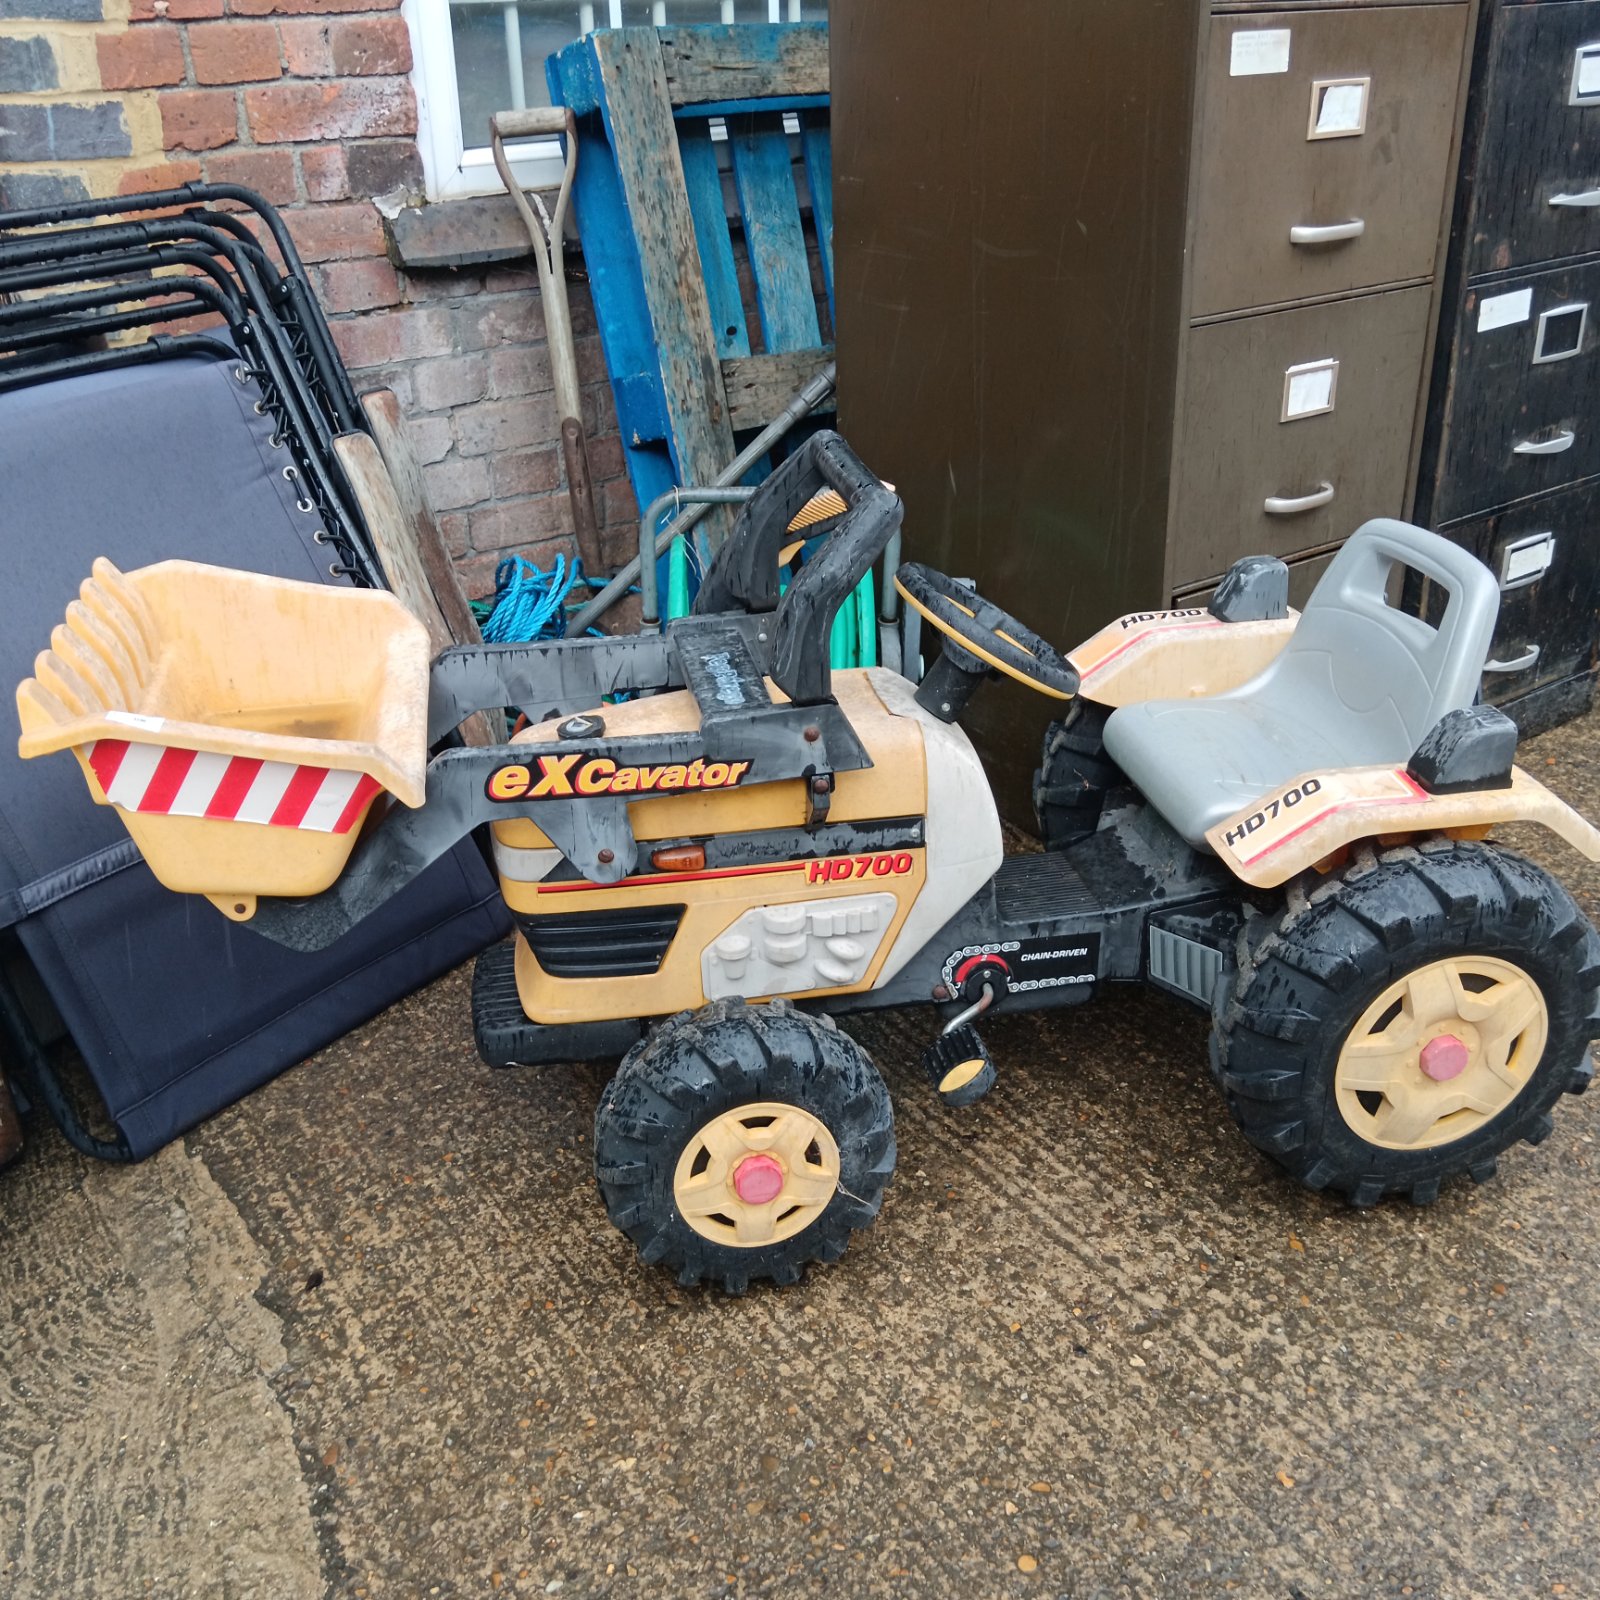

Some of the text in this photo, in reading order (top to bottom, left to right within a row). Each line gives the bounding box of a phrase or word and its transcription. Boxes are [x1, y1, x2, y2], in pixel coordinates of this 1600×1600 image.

[1121, 609, 1202, 629] HD700
[1226, 778, 1321, 846] HD700
[808, 853, 912, 883] HD700
[1021, 948, 1088, 961] CHAIN-DRIVEN
